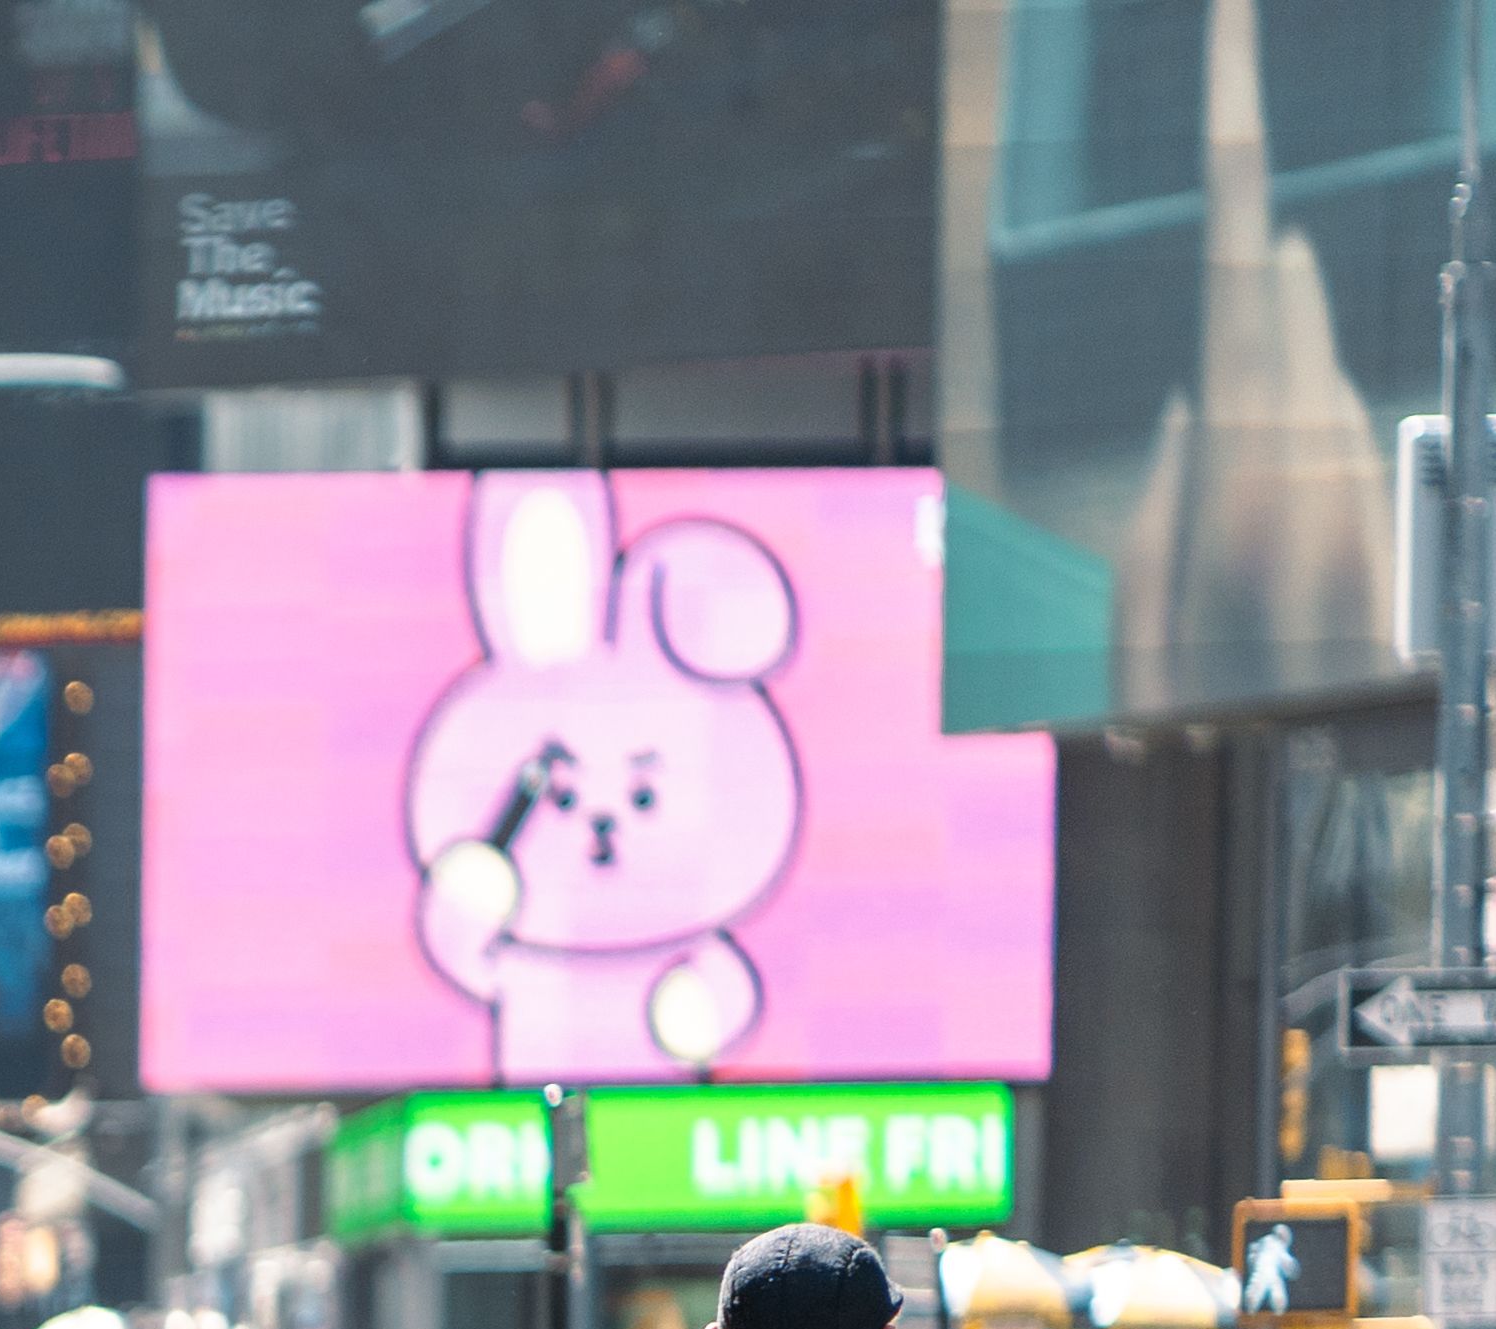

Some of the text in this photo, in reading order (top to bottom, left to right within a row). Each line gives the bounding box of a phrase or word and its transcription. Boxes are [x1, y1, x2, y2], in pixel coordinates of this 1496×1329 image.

[177, 192, 295, 234] Save
[181, 235, 276, 274] The
[174, 270, 320, 321] Music
